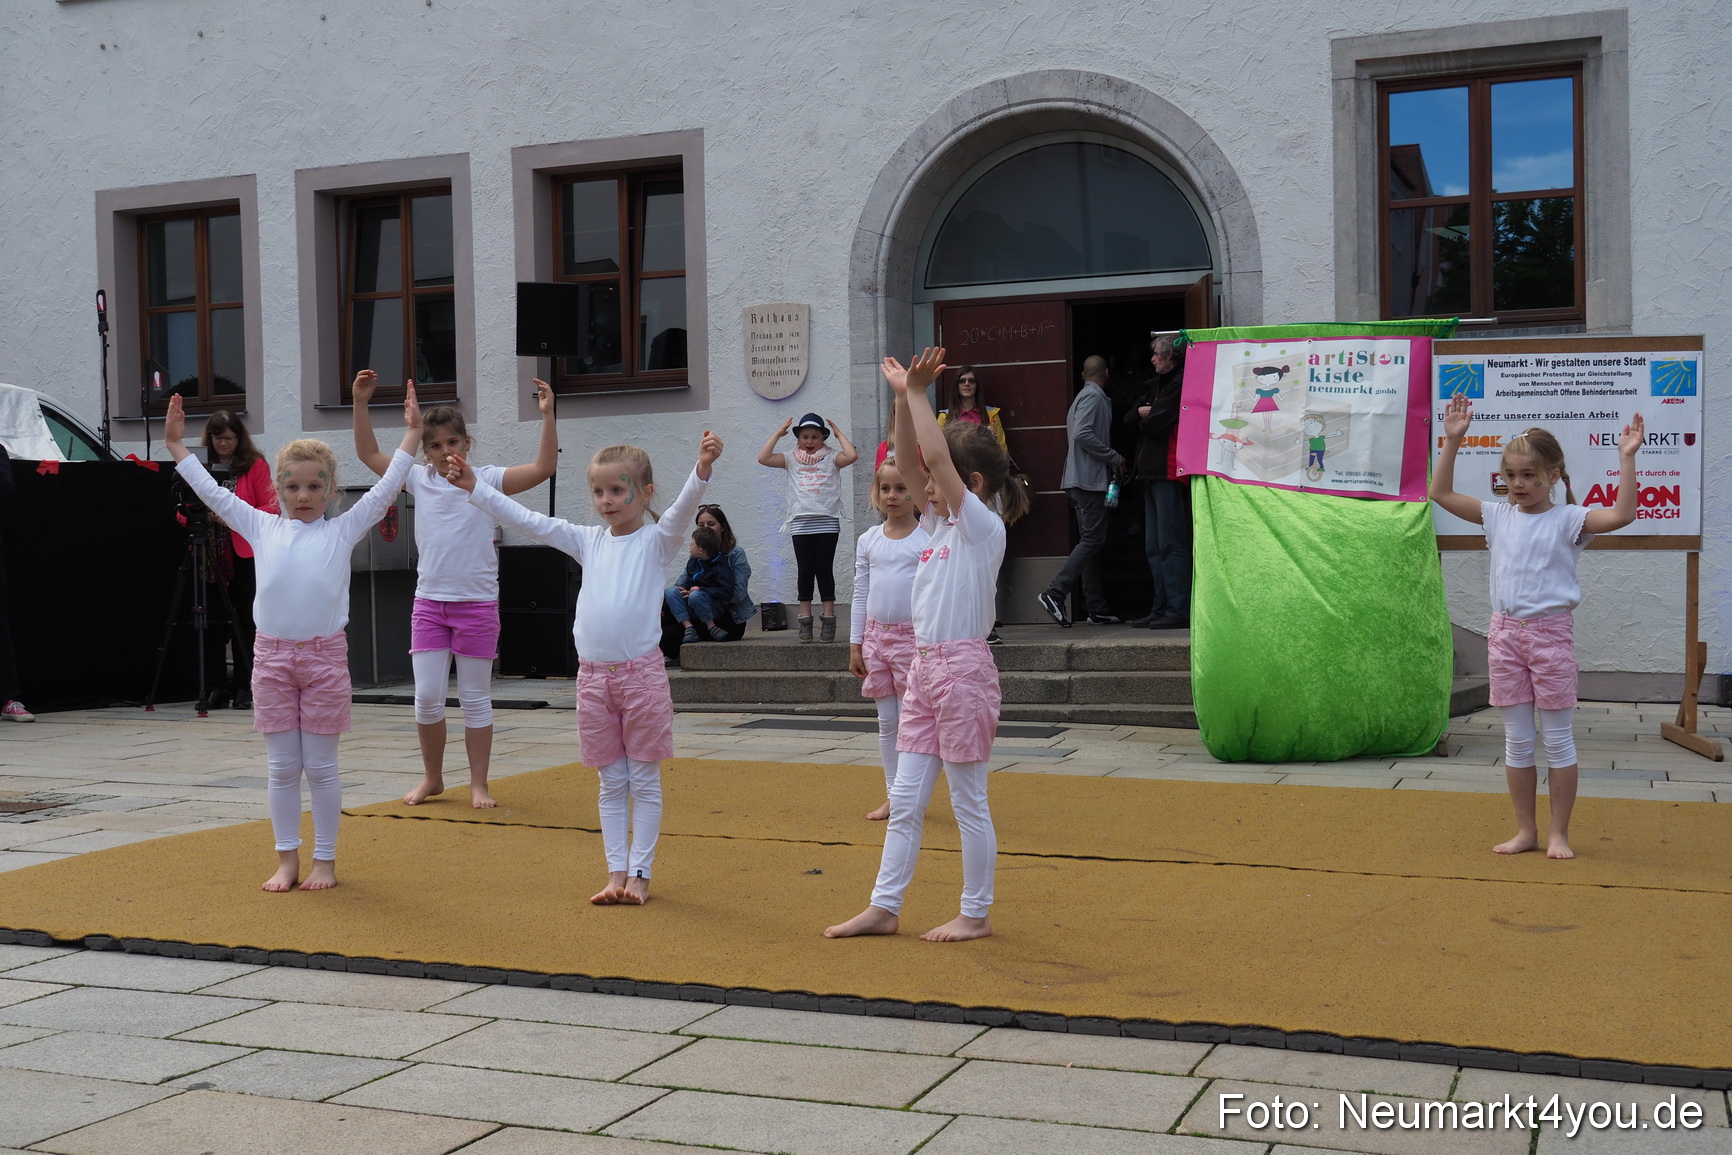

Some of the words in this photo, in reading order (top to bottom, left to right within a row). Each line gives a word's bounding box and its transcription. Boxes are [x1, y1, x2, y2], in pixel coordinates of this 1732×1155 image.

[751, 313, 799, 324] Rathaus
[1487, 359, 1528, 368] Neumarkt
[1535, 358, 1549, 367] Wir
[1551, 358, 1590, 370] gestalten
[1593, 359, 1621, 367] unsere
[1623, 356, 1647, 366] Stadt
[751, 369, 799, 378] Generalsanierung
[1309, 367, 1364, 384] kiste
[1542, 371, 1575, 379] Protesttag
[1587, 370, 1633, 378] Gleichstellung
[1575, 379, 1615, 387] Behinderung
[1308, 385, 1373, 395] neumarkt
[1495, 389, 1559, 399] Arbeitsgemeinschaft
[1559, 388, 1581, 396] Offene
[1581, 387, 1638, 396] Behindertenarbeit
[1437, 412, 1501, 421] Utützer
[1503, 412, 1542, 420] unserer
[1544, 411, 1586, 419] sozialen
[1588, 410, 1620, 419] Arbeit
[1589, 432, 1680, 447] NEUARKT
[1634, 509, 1680, 520] ENSCH
